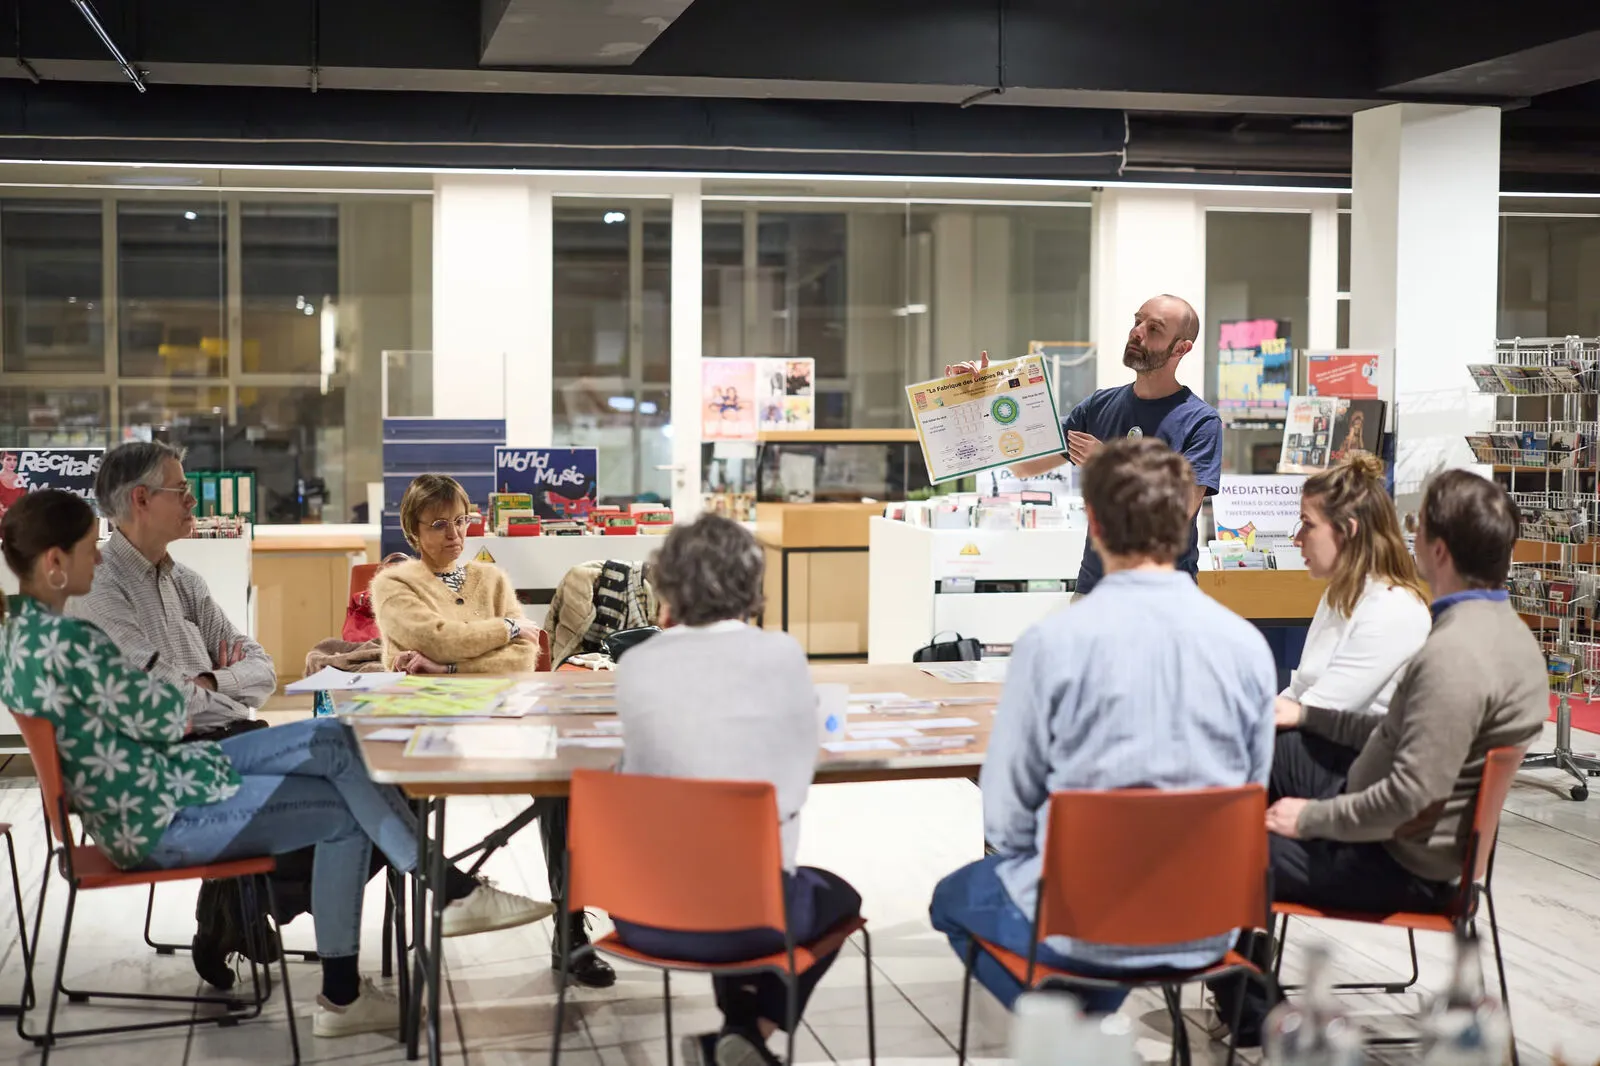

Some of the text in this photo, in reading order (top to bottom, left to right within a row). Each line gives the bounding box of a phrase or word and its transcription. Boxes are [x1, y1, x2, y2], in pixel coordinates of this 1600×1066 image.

[937, 382, 961, 392] Fabrique
[18, 451, 100, 476] Récitals
[498, 451, 549, 472] World
[13, 472, 30, 488] &
[534, 465, 584, 486] Music
